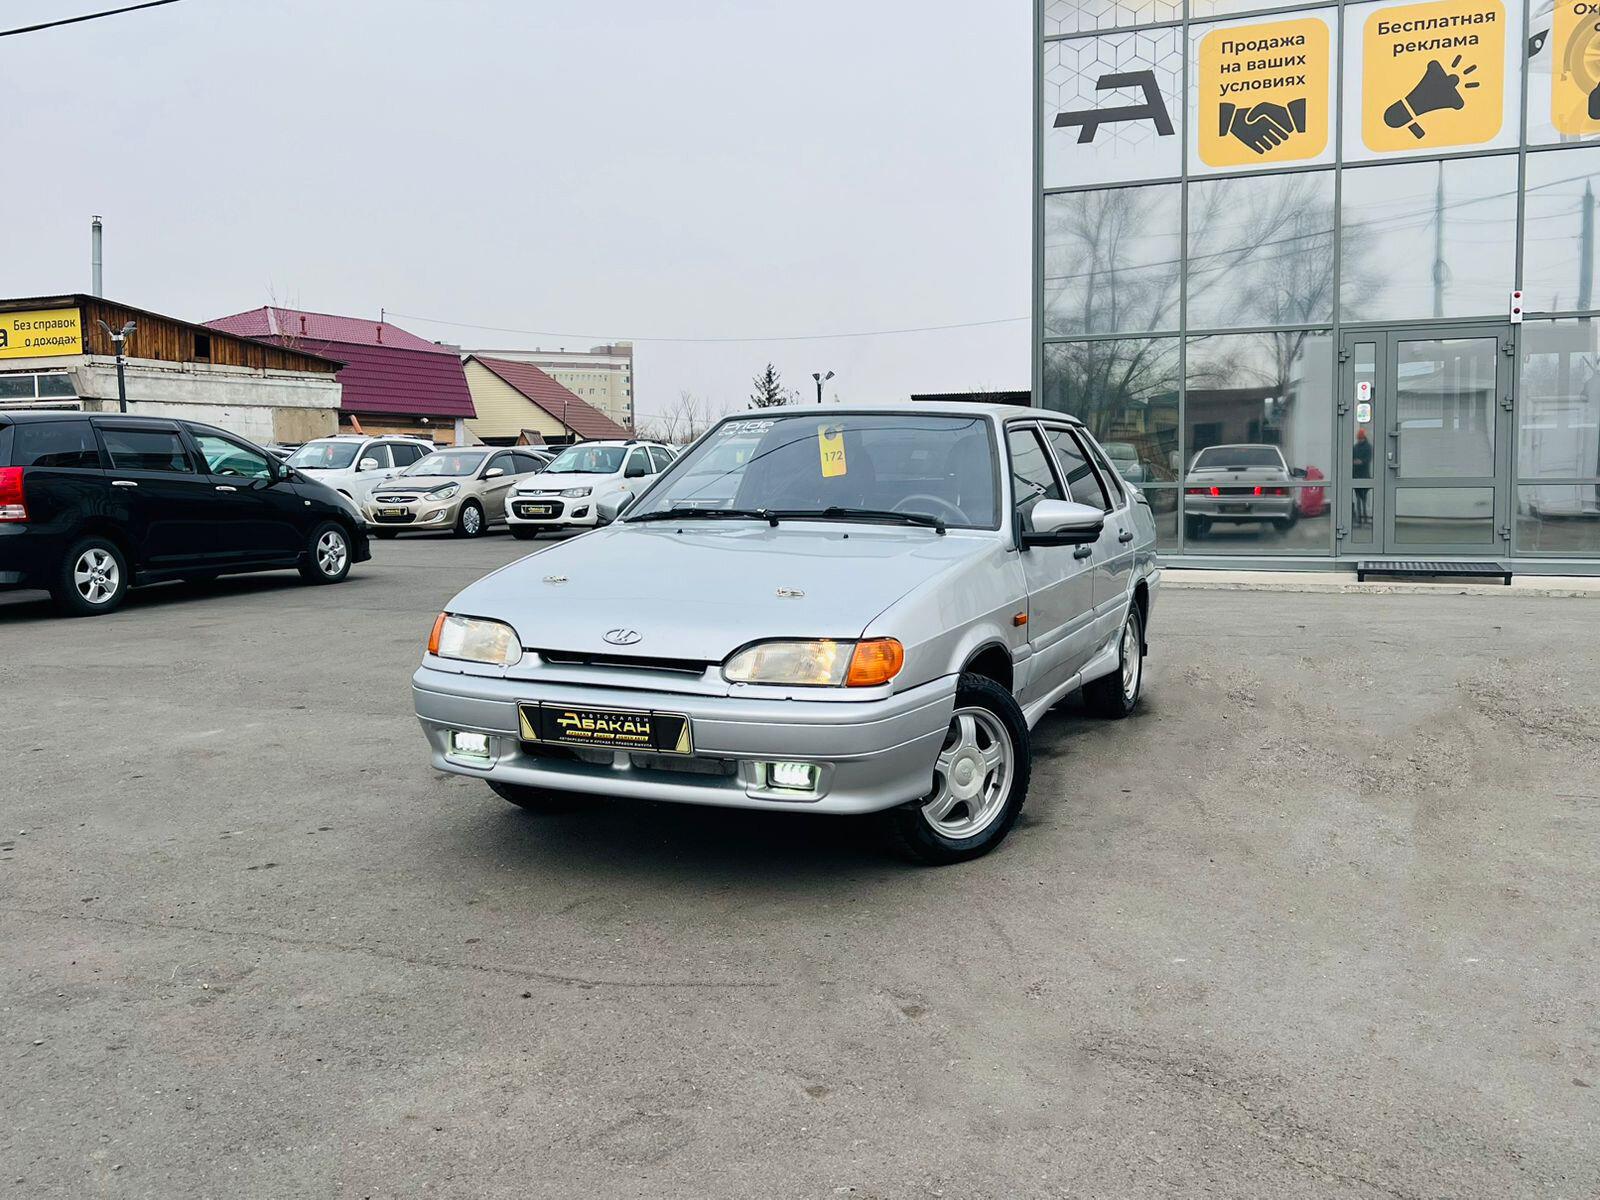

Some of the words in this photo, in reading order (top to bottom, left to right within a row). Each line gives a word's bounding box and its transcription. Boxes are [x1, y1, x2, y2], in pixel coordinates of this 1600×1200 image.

[1573, 3, 1600, 16] Ох
[1378, 12, 1496, 36] Бесплатная
[1221, 35, 1305, 56] Продажа
[1393, 34, 1479, 57] реклама
[1220, 62, 1241, 74] на
[1247, 54, 1306, 71] ваших
[1219, 74, 1306, 97] условиях
[13, 320, 31, 331] Без
[33, 319, 76, 331] справок
[25, 338, 31, 347] о
[33, 335, 77, 347] доходах
[722, 420, 775, 431] Pride
[825, 451, 843, 462] 172
[581, 713, 649, 722] АВТОСАЛОН
